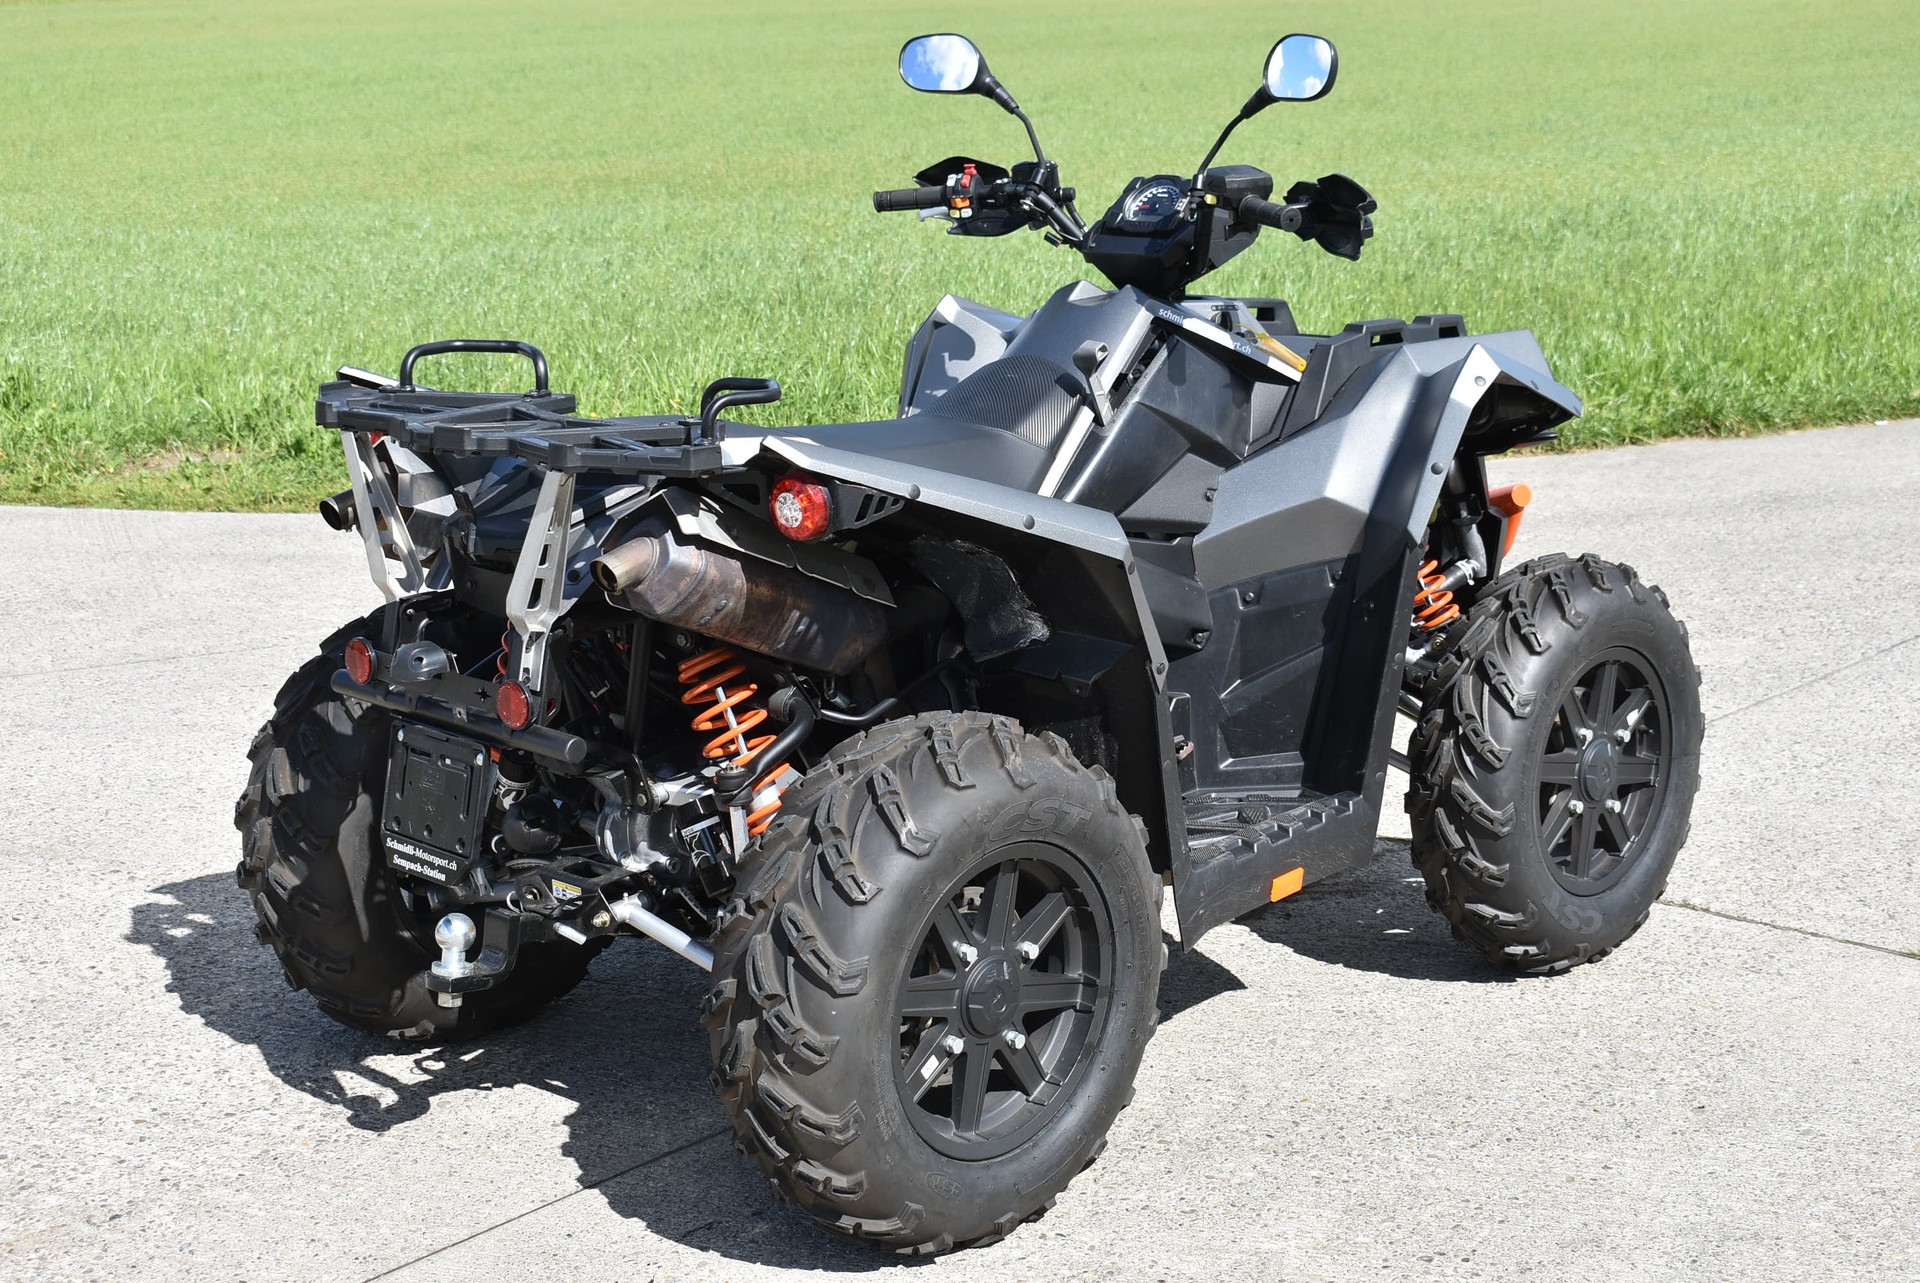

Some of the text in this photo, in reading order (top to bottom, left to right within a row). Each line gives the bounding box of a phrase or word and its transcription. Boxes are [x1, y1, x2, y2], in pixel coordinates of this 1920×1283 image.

[988, 798, 1092, 841] CST
[386, 837, 457, 871] Schmidli-Motorsport.ch
[393, 854, 446, 881] Sempach-Station
[1541, 887, 1603, 935] CST
